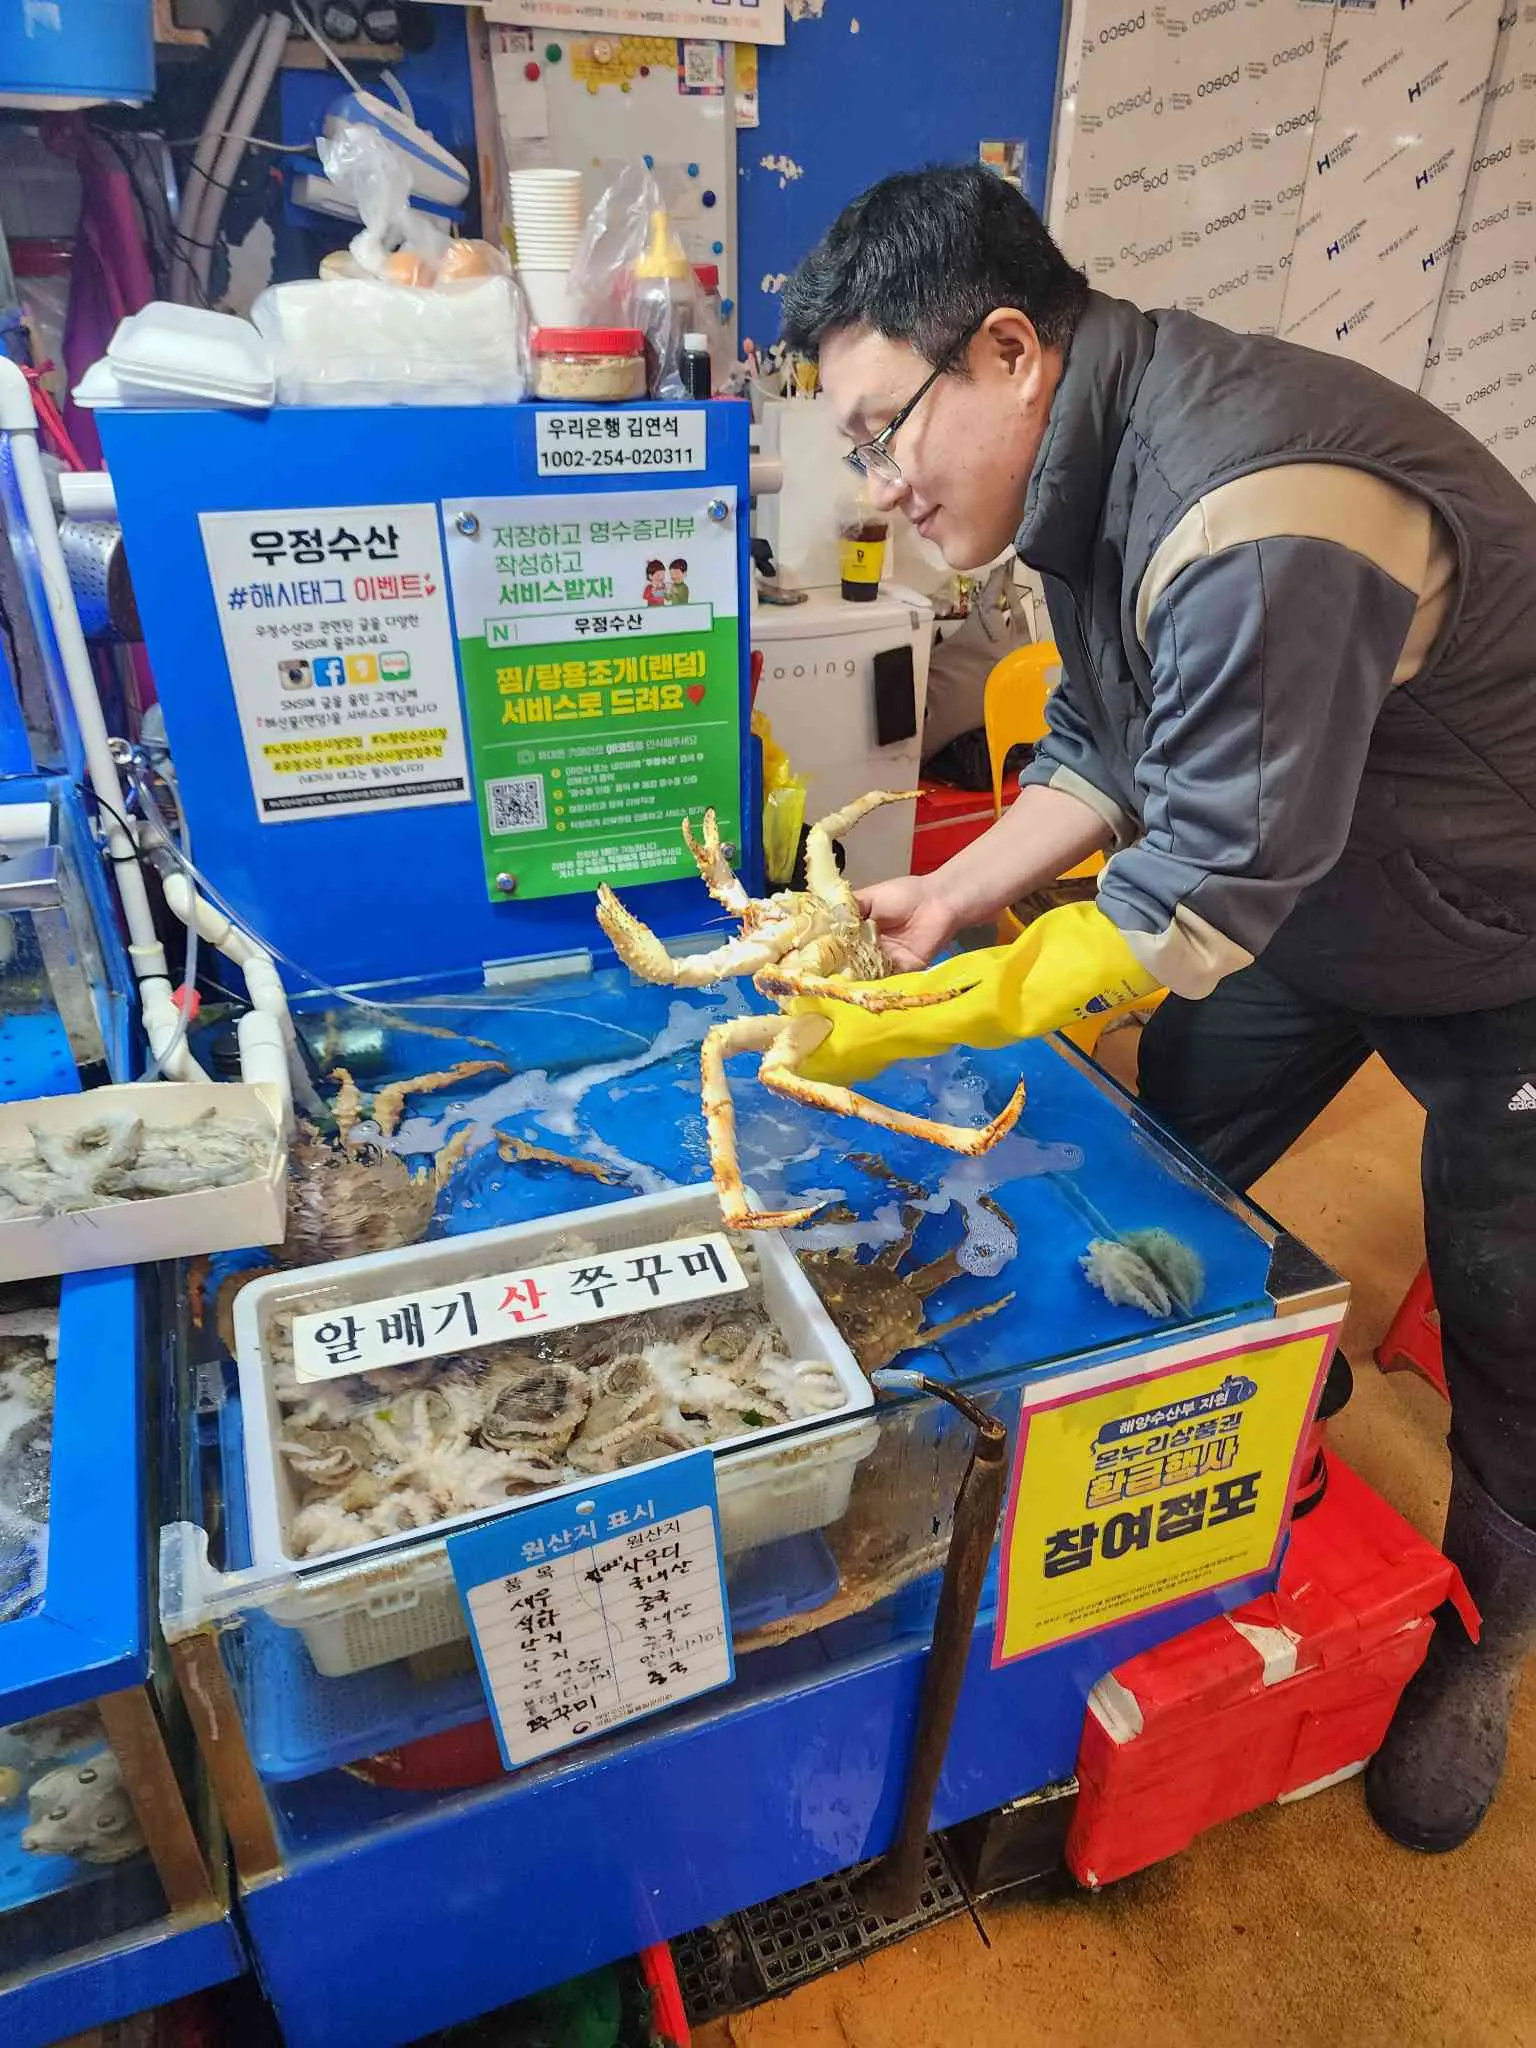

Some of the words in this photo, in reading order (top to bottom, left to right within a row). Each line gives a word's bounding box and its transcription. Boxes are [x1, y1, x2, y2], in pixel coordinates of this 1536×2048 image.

[1100, 11, 1145, 44] posco
[1197, 66, 1240, 97] posco
[1275, 105, 1316, 136] posco
[1473, 142, 1512, 172] posco
[1205, 204, 1246, 234] posco
[1470, 264, 1507, 292] posco
[1465, 376, 1501, 404] posco
[548, 417, 620, 440] 우리은행
[627, 416, 679, 438] 김연석
[541, 448, 693, 468] 1002-254-020311
[250, 524, 399, 567] 우정수산
[492, 522, 582, 549] 저장하고
[589, 517, 695, 543] 영수증리뷰
[495, 551, 583, 577] 작성하고
[228, 578, 346, 610] #해시태그
[354, 573, 423, 601] 이벤트
[498, 577, 614, 606] 서비스받자!
[255, 621, 314, 639] 우정수산과
[385, 614, 419, 629] 다양한
[575, 614, 643, 634] 우정수산
[496, 650, 706, 695] 찜/탕용조개(랜덤)
[502, 691, 603, 726] 서비스로
[610, 685, 684, 715] 드려요
[314, 1291, 480, 1365] 알배기
[497, 1278, 549, 1324] 산
[568, 1243, 728, 1310] 쭈꾸미
[1119, 1402, 1196, 1434] 해양수산부
[1199, 1391, 1228, 1410] 지원
[1095, 1412, 1243, 1471] 온누리상품권
[1086, 1435, 1239, 1509] 환급행사
[521, 1520, 597, 1562] 원산지
[607, 1500, 655, 1531] 표시
[626, 1520, 680, 1549] 원산지
[1043, 1471, 1262, 1579] 참여점포
[623, 1542, 680, 1573] 사우디
[510, 1588, 552, 1612] 새우
[629, 1561, 693, 1590] 국내산
[514, 1609, 560, 1634] 석화
[636, 1589, 671, 1612] 중국
[635, 1603, 692, 1630] 국내산
[526, 1695, 597, 1734] 쭈꾸미
